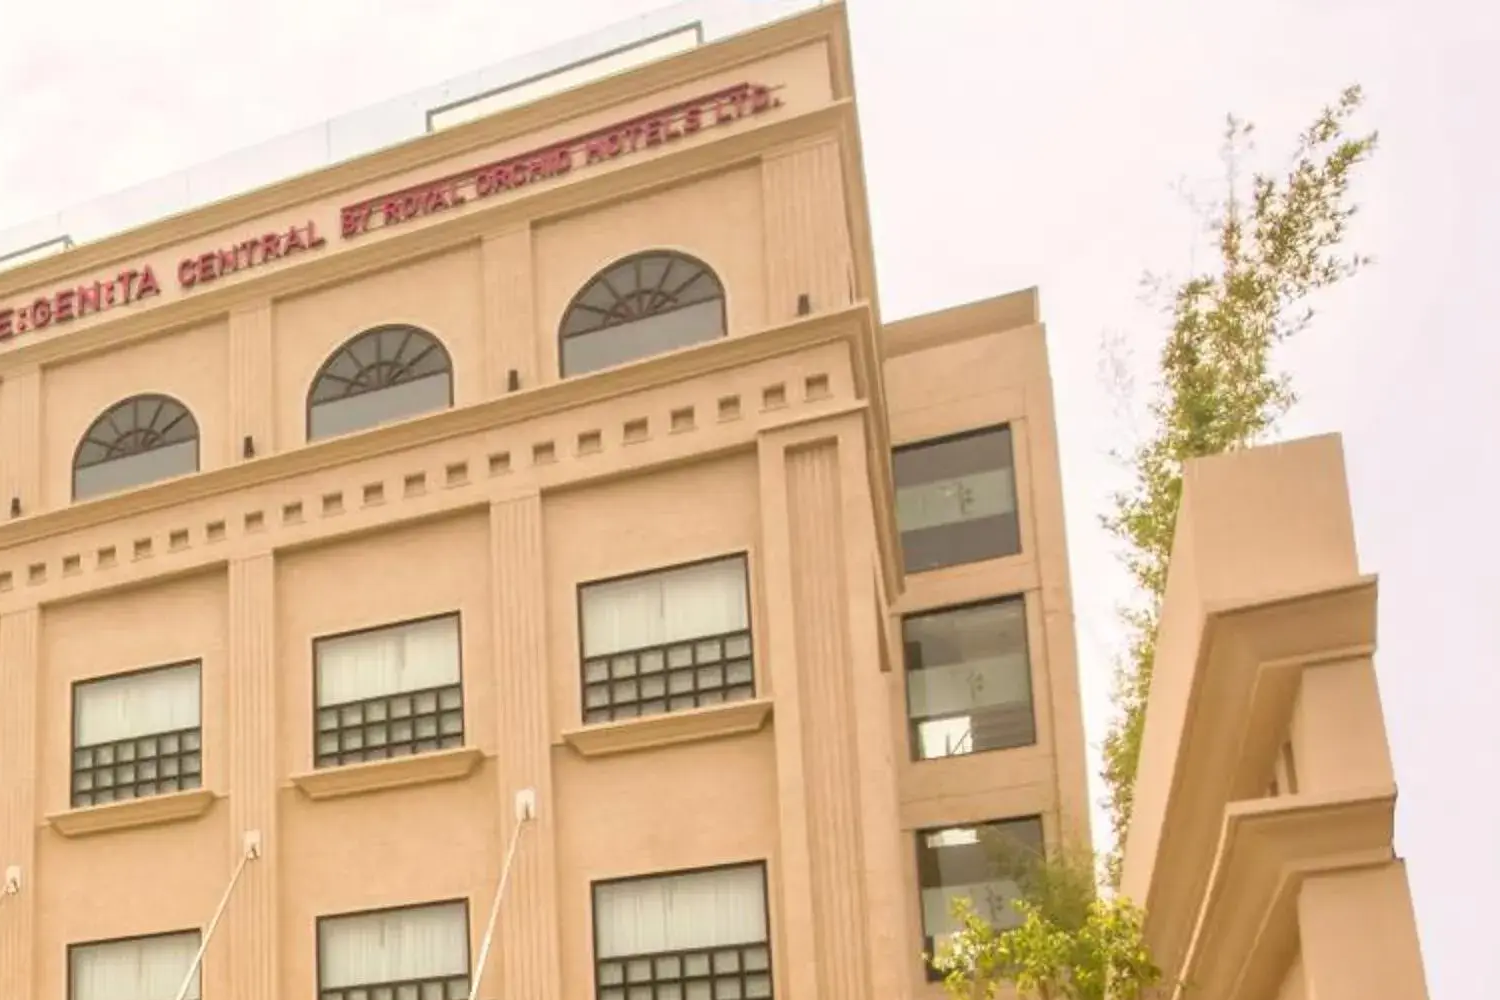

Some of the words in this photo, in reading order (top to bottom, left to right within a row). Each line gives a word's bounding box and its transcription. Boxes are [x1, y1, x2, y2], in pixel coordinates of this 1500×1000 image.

[177, 220, 327, 288] CENTRAL
[340, 203, 372, 239] BY
[383, 184, 466, 226] ROYAL
[476, 149, 572, 198] ORCHID
[586, 108, 701, 166] HOTELS
